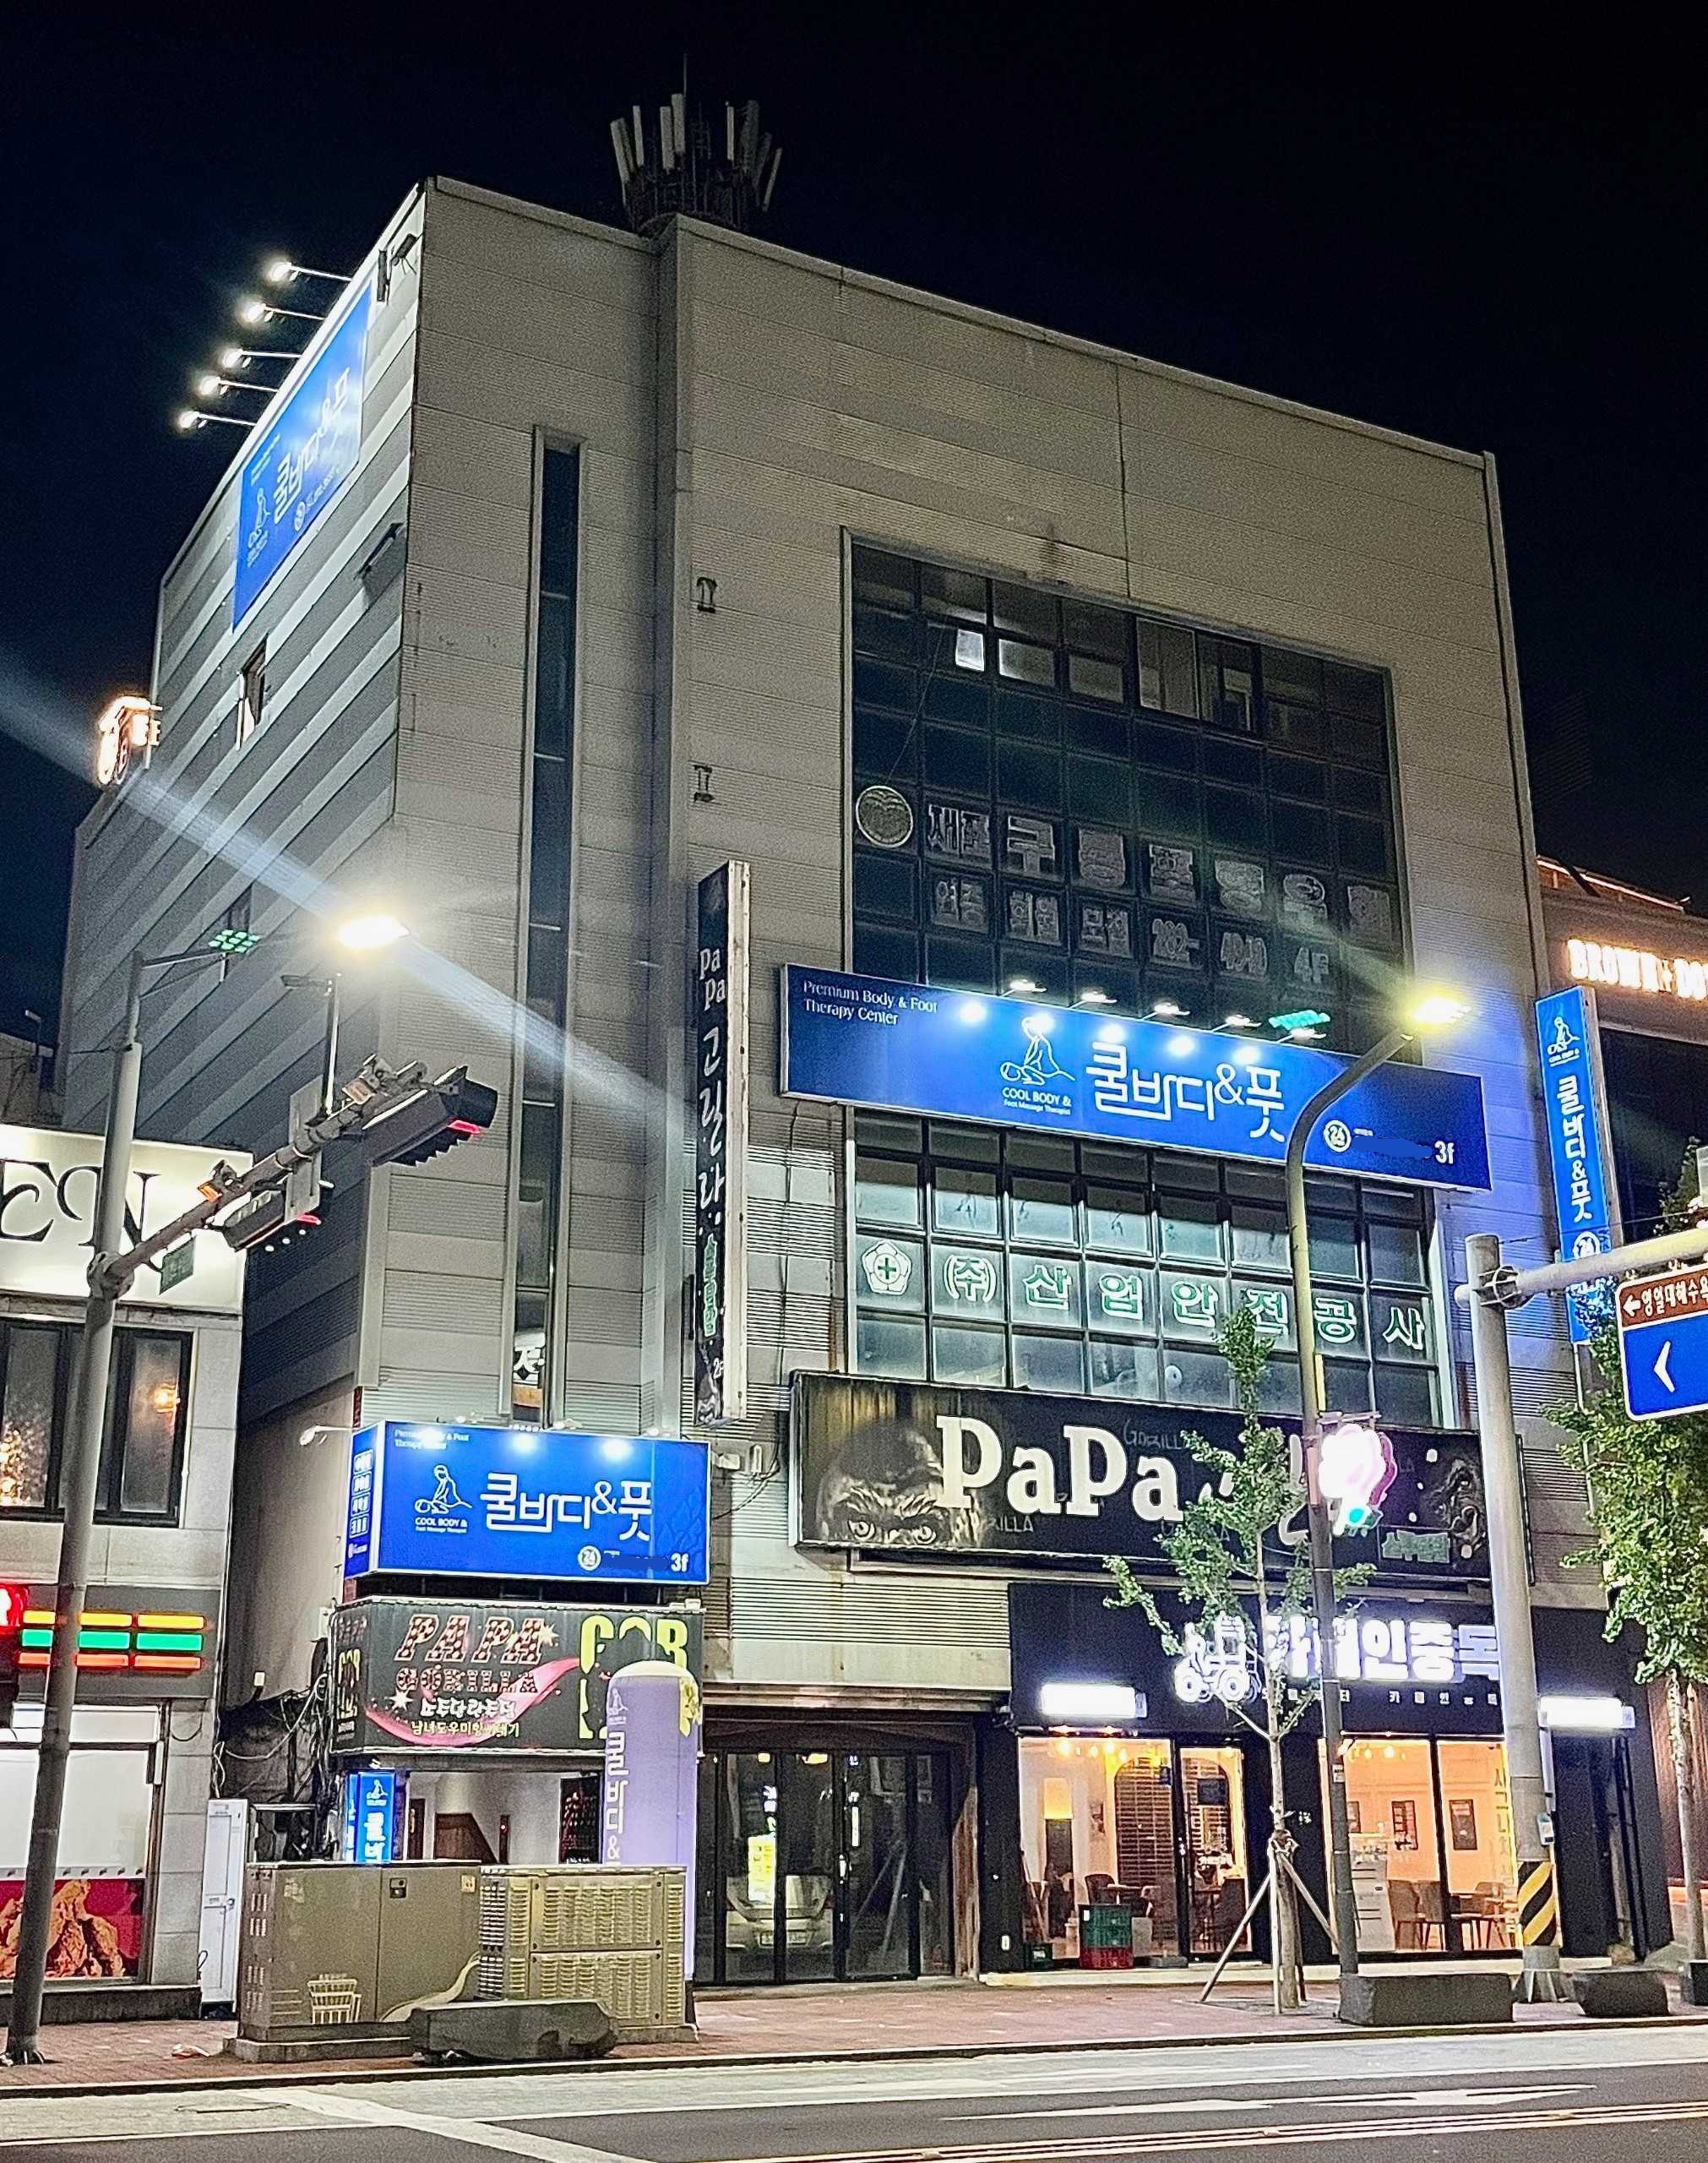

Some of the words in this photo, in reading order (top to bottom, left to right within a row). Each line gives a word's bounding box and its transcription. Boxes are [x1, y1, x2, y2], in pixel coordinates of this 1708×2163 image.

[803, 980, 859, 1003] Premium
[862, 989, 894, 1009] Body
[899, 995, 907, 1010] &
[911, 996, 938, 1013] Foot
[803, 998, 856, 1022] Therapy
[857, 1005, 899, 1026] Center
[1002, 1087, 1031, 1101] COOL
[1032, 1091, 1061, 1105] BODY
[1063, 1095, 1072, 1107] &
[1086, 1040, 1286, 1143] 쿨바디&풋
[1556, 1075, 1593, 1223] 쿨바디&풋
[1123, 1419, 1183, 1450] GORILL
[935, 1414, 1184, 1522] PaPa
[415, 1517, 437, 1526] COOL
[438, 1517, 460, 1527] BODY
[479, 1473, 653, 1541] 쿨바디&풋
[394, 1613, 546, 1664] PAPA
[606, 1731, 629, 1866] 쿨바디&
